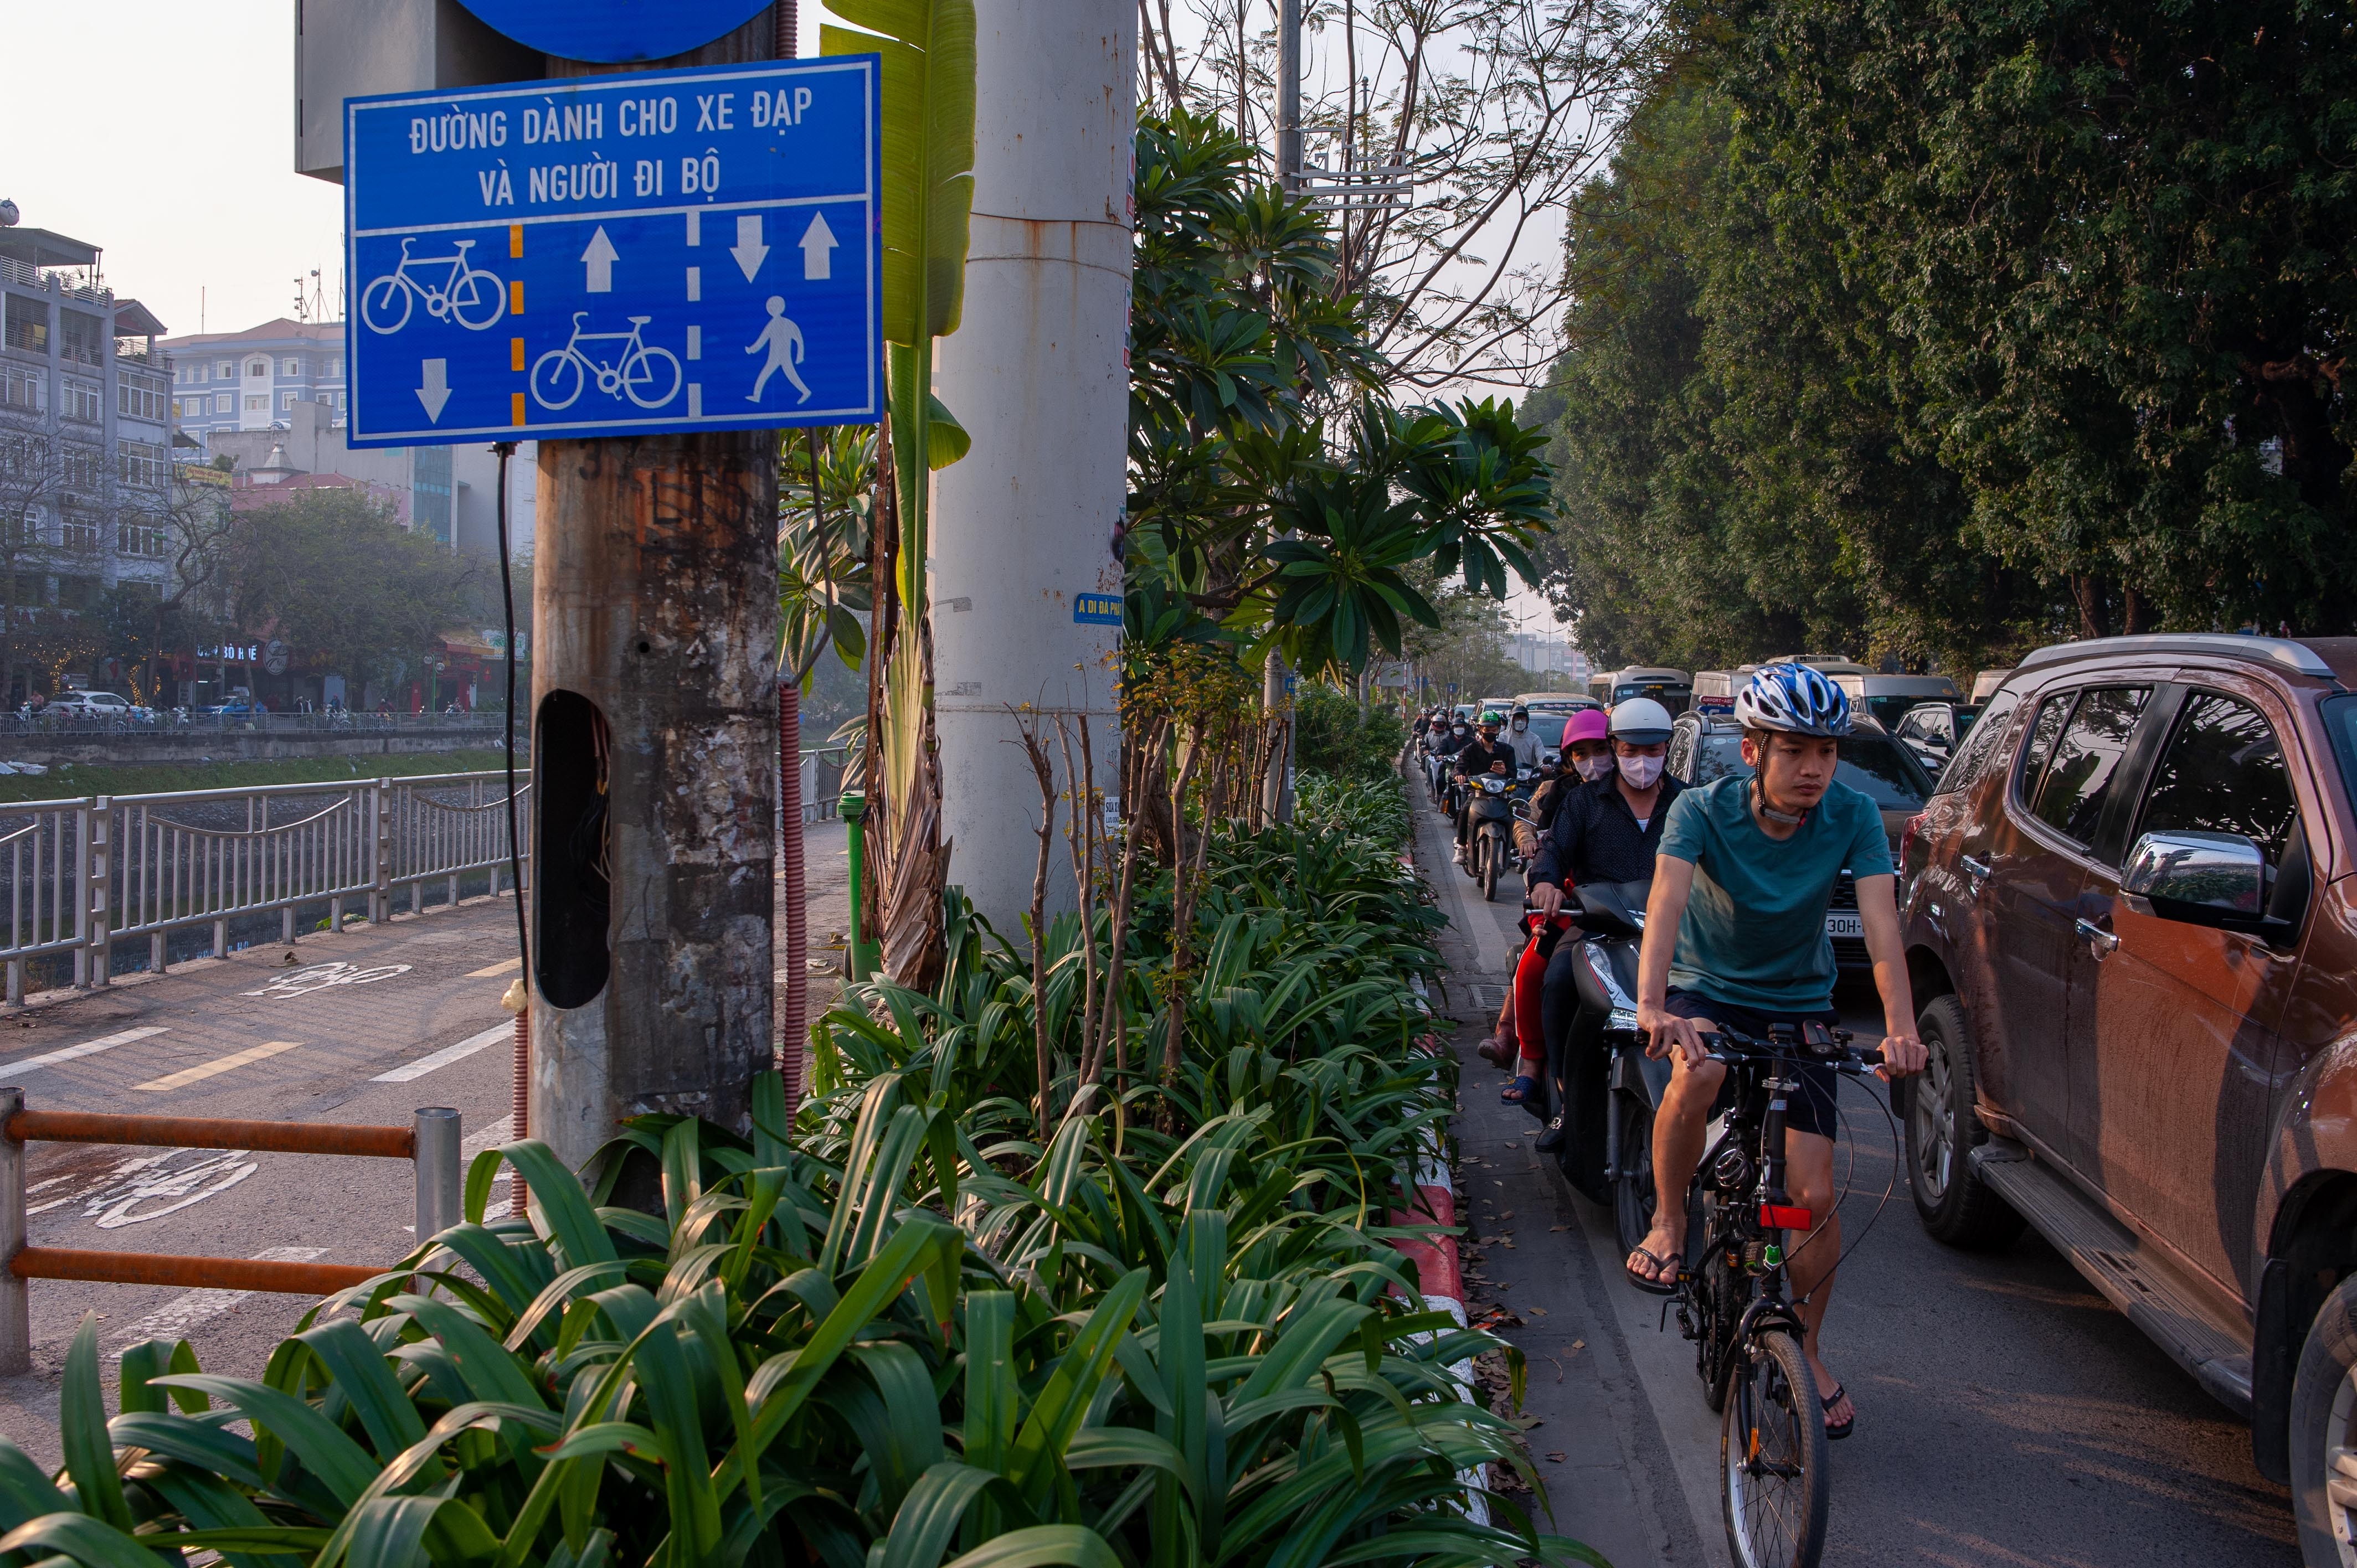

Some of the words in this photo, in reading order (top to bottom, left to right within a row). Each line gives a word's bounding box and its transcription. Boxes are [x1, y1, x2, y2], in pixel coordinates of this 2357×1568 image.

[409, 104, 506, 153] ĐƯỜNG
[524, 97, 602, 143] DÀNH
[620, 97, 677, 136] CHO
[697, 94, 734, 131] XE
[750, 87, 811, 136] ĐẠP
[478, 159, 513, 206] VÀ
[530, 152, 617, 203] NGƯỜI
[634, 159, 662, 196] ĐI
[682, 148, 719, 202] BỘ
[1079, 600, 1085, 613] A
[1088, 600, 1097, 613] DI
[1099, 598, 1109, 615] ĐÀ
[1828, 920, 1865, 932] 30H-
